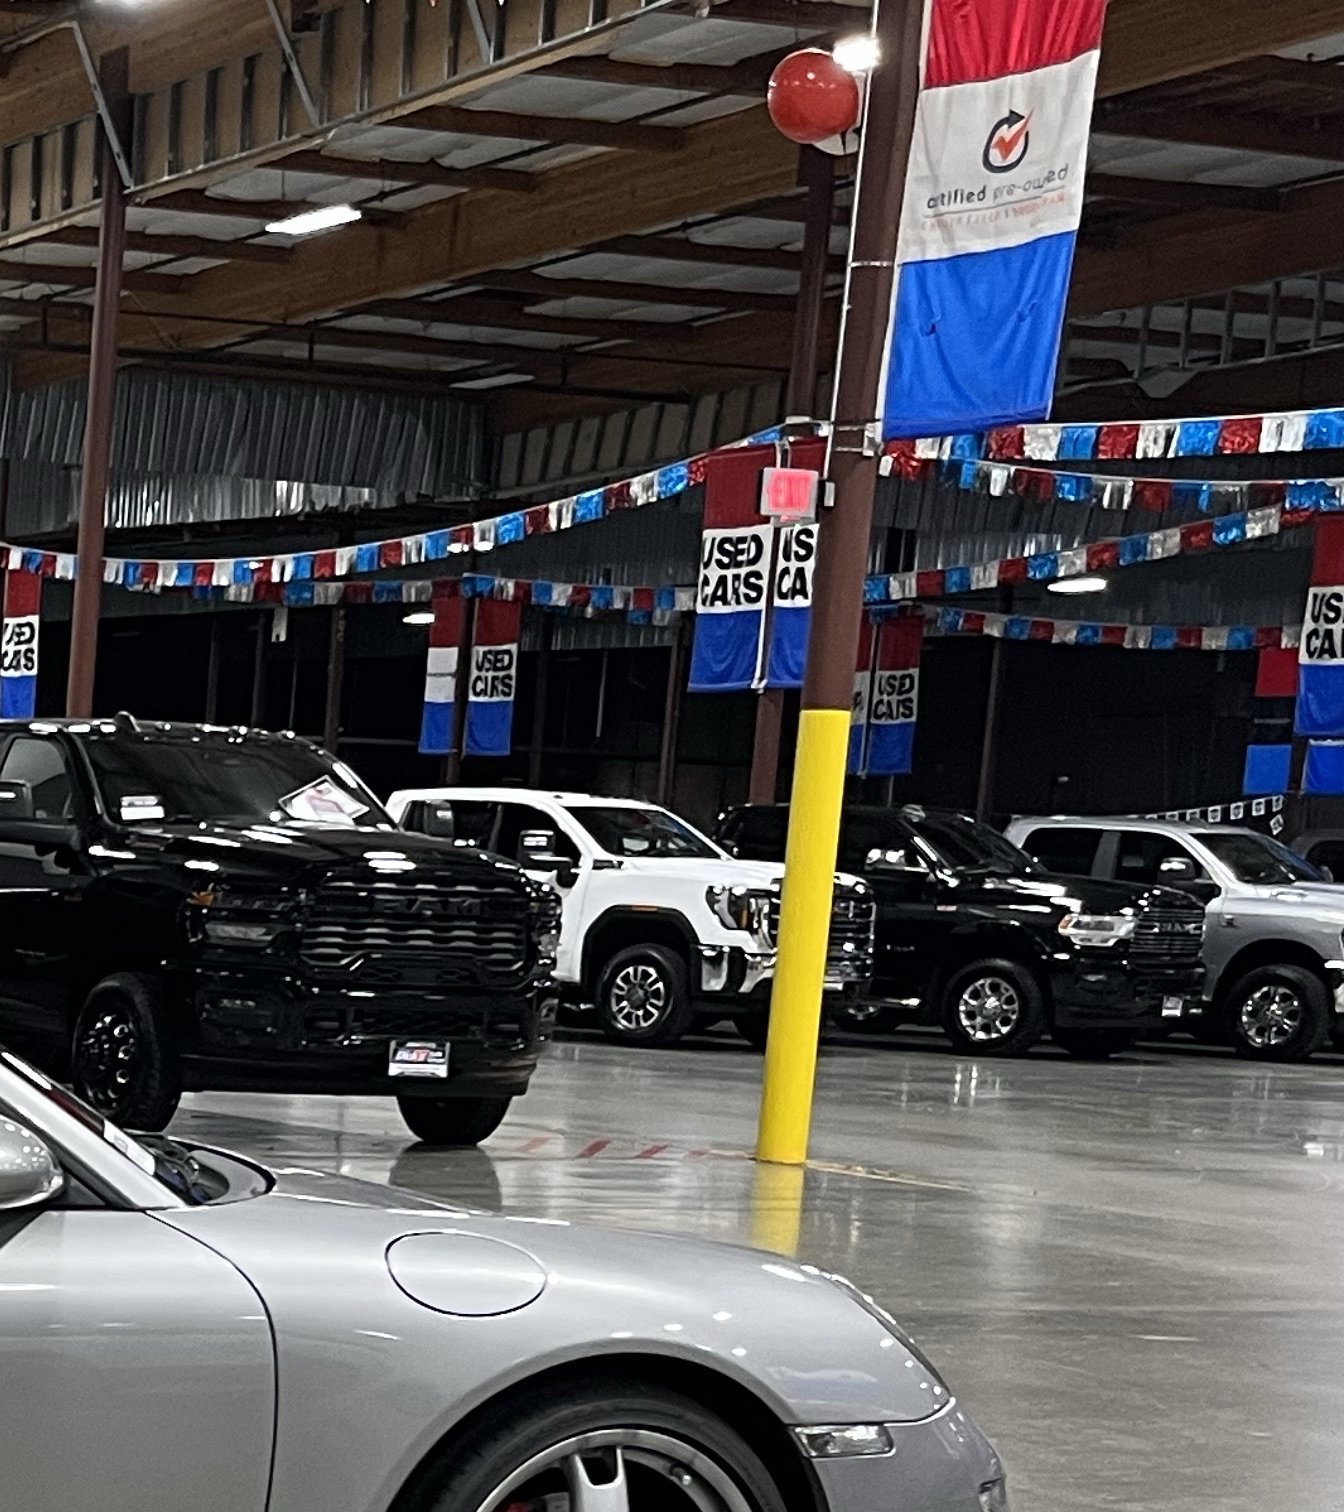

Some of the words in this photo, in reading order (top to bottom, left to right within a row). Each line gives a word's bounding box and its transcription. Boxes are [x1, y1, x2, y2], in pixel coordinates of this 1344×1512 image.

[927, 185, 986, 209] ctified
[993, 163, 1069, 203] pre-owed
[702, 534, 764, 570] USED
[701, 570, 764, 607] CARS
[1311, 592, 1344, 625] US
[1306, 627, 1344, 659] CA
[475, 649, 513, 673] USED
[873, 697, 914, 720] CAS
